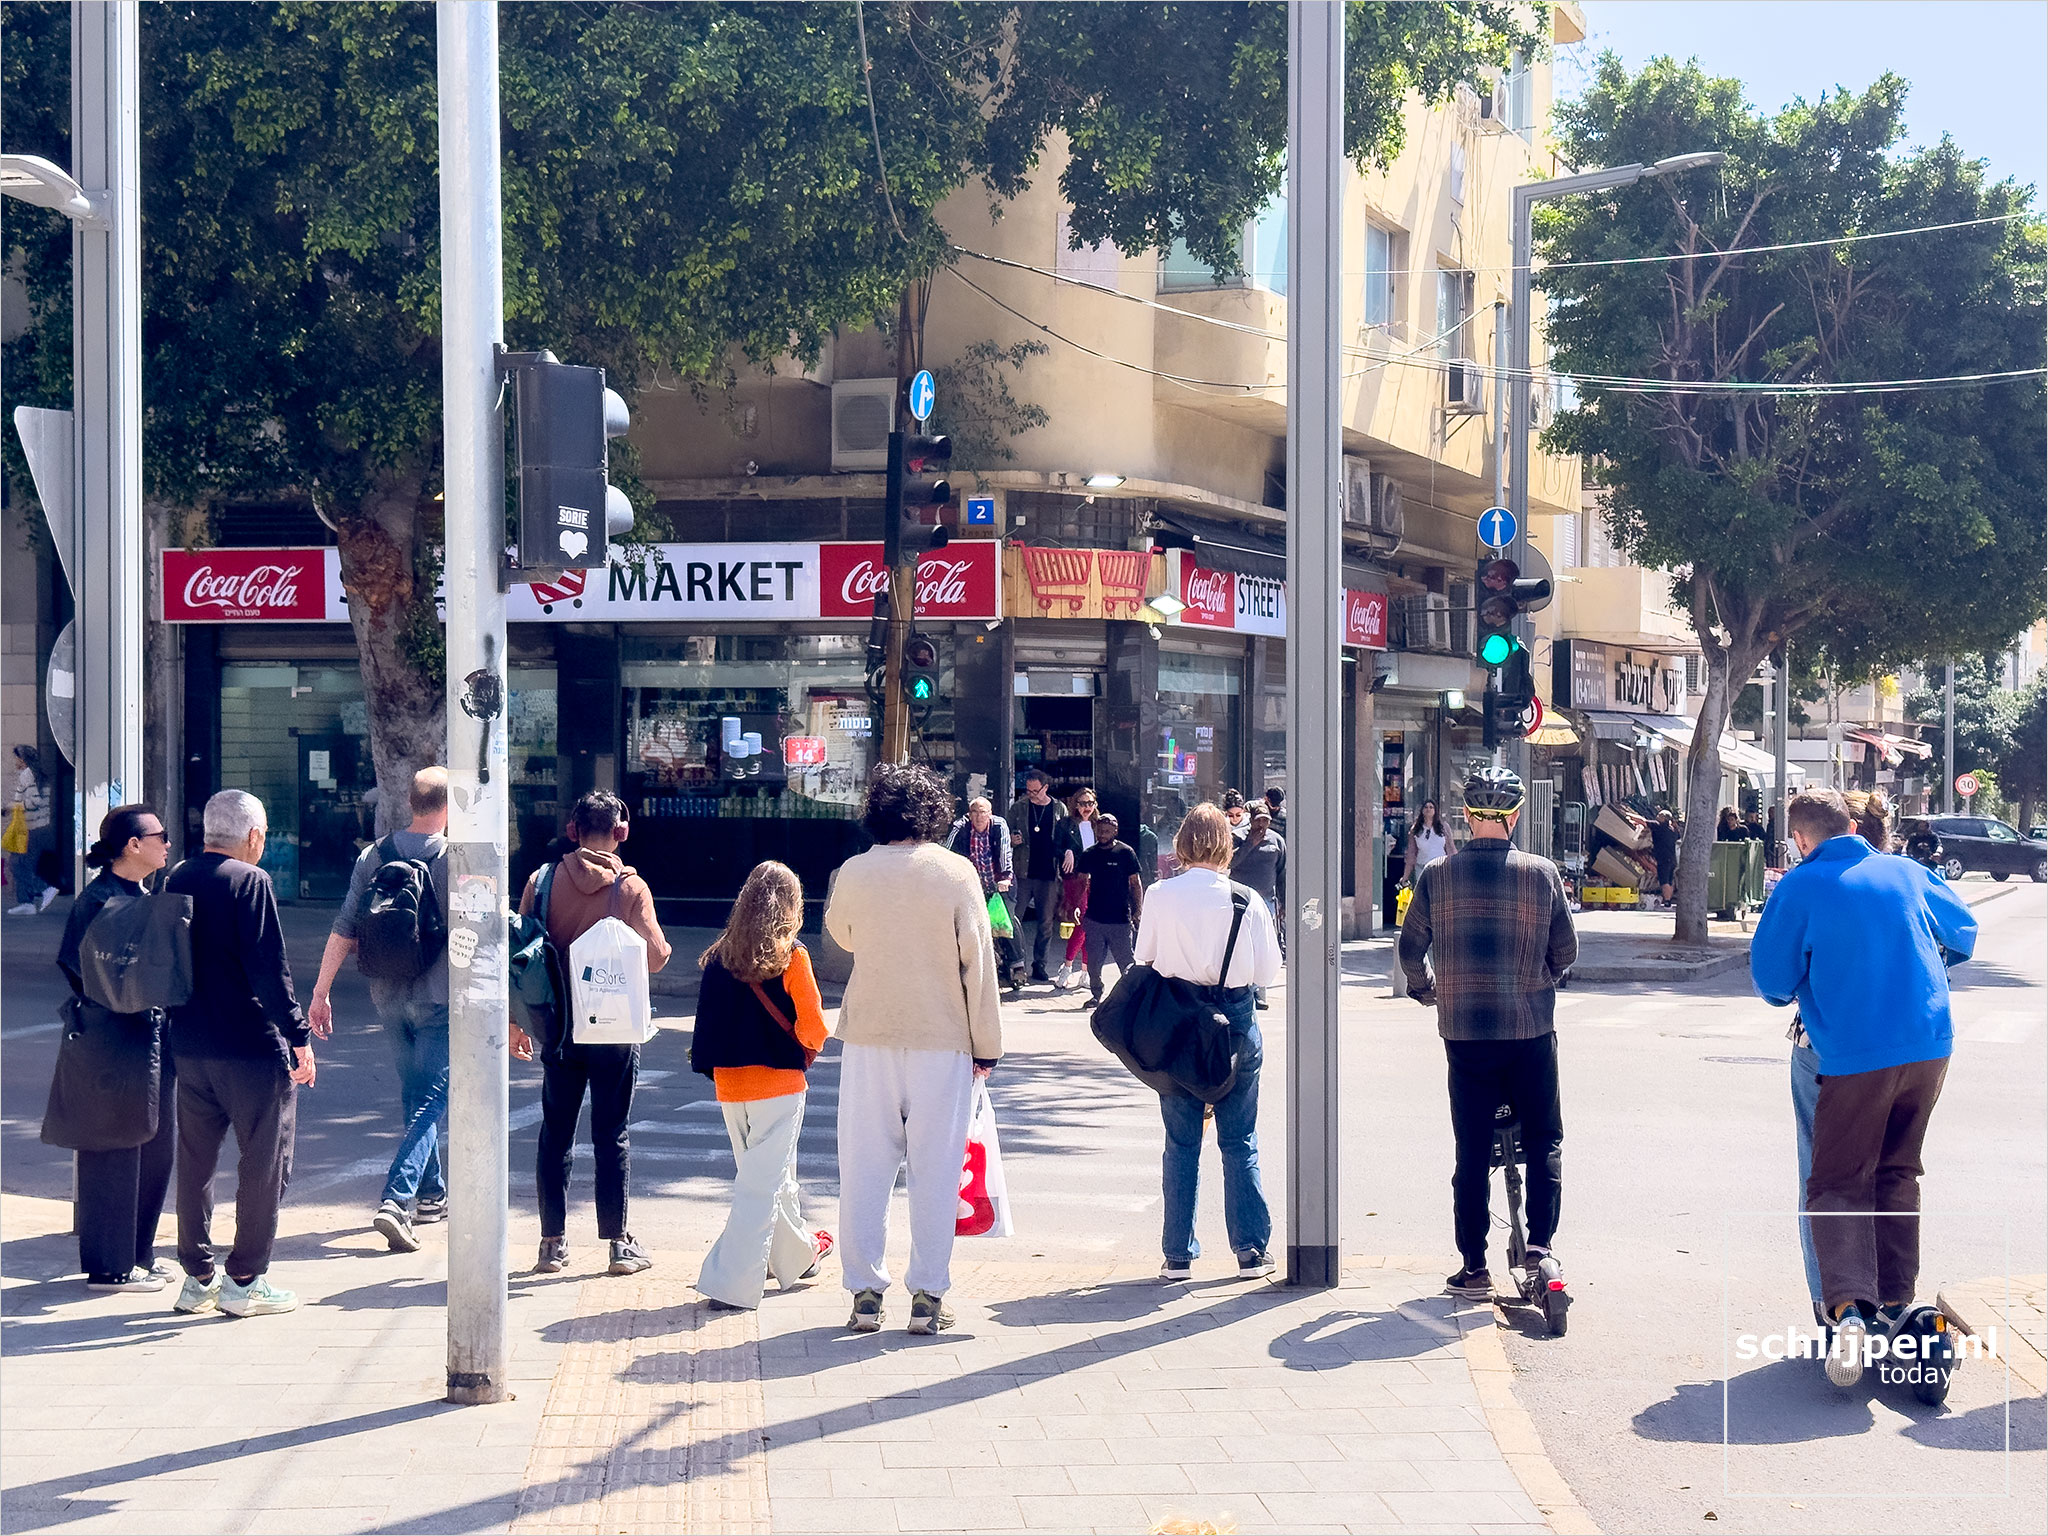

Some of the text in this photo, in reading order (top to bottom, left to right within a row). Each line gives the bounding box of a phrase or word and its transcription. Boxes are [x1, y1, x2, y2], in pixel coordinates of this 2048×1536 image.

[559, 509, 588, 526] SORIE
[976, 505, 986, 519] 2
[184, 566, 304, 607] Coca-Cola
[608, 561, 803, 602] MARKET
[1187, 567, 1229, 614] Coca-Cola
[1238, 577, 1281, 619] STREET
[839, 717, 872, 729] כוסות
[812, 740, 819, 748] 3
[795, 749, 814, 762] 14
[1960, 780, 1974, 789] 30
